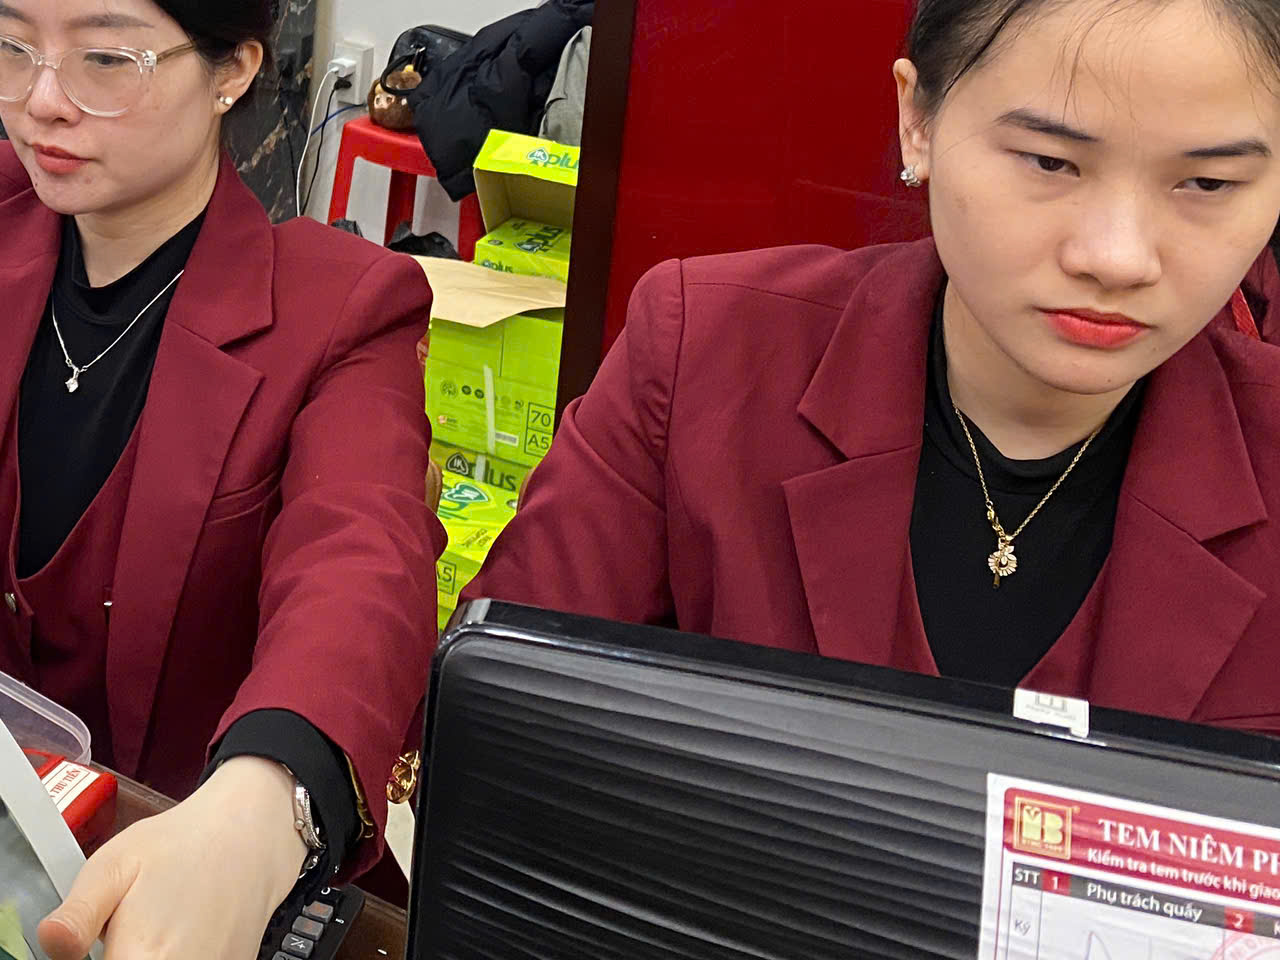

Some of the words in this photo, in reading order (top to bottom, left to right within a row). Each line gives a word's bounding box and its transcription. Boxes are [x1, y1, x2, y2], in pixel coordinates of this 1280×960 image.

[531, 410, 551, 427] 70
[528, 434, 549, 450] A5
[1099, 818, 1160, 852] TEM
[1168, 833, 1244, 869] NIÊM
[1127, 859, 1147, 873] tra
[1151, 862, 1179, 880] tem
[1224, 876, 1247, 894] khi
[1014, 868, 1041, 884] STT
[1052, 877, 1059, 890] 1
[1087, 882, 1117, 905] Phụ
[1121, 892, 1160, 912] trách
[1232, 914, 1244, 929] 2
